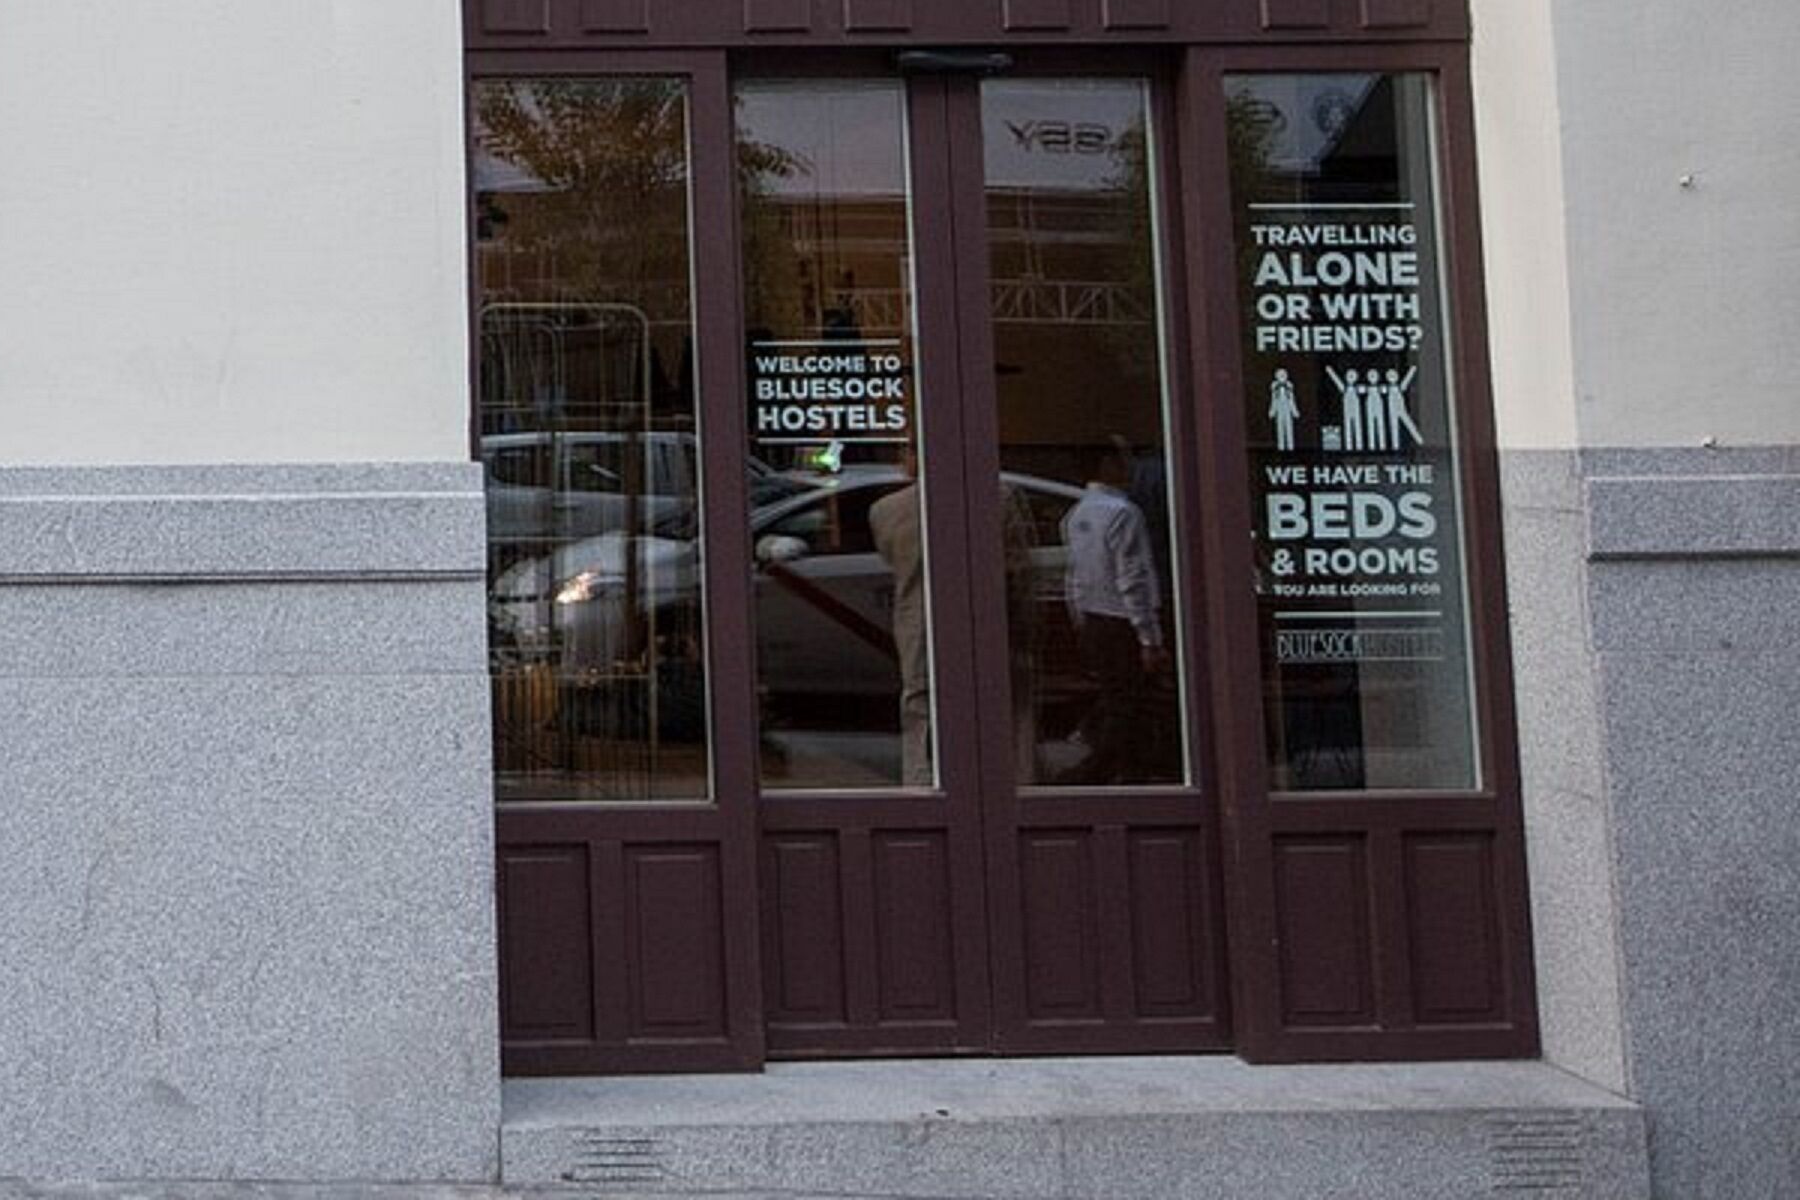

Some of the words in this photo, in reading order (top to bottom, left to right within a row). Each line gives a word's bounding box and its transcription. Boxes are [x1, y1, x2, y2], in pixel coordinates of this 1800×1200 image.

[1251, 224, 1417, 245] TRAVELLING
[1255, 252, 1420, 287] ALONE
[1257, 293, 1311, 320] OR
[1319, 292, 1421, 320] WITH
[1256, 325, 1423, 352] FRIENDS?
[755, 355, 865, 374] WELCOME
[869, 355, 901, 373] TO
[756, 377, 903, 400] BLUESOCK
[757, 405, 907, 431] HOSTELS
[1266, 465, 1307, 485] WE
[1312, 465, 1380, 485] HAVE
[1385, 464, 1434, 484] THE
[1268, 491, 1437, 540] BEDS
[1271, 549, 1295, 576] &
[1305, 547, 1440, 575] ROOMS
[1274, 584, 1306, 596] YOU
[1308, 584, 1338, 596] ARE
[1340, 584, 1408, 596] LOOKING
[1410, 583, 1441, 596] FOR
